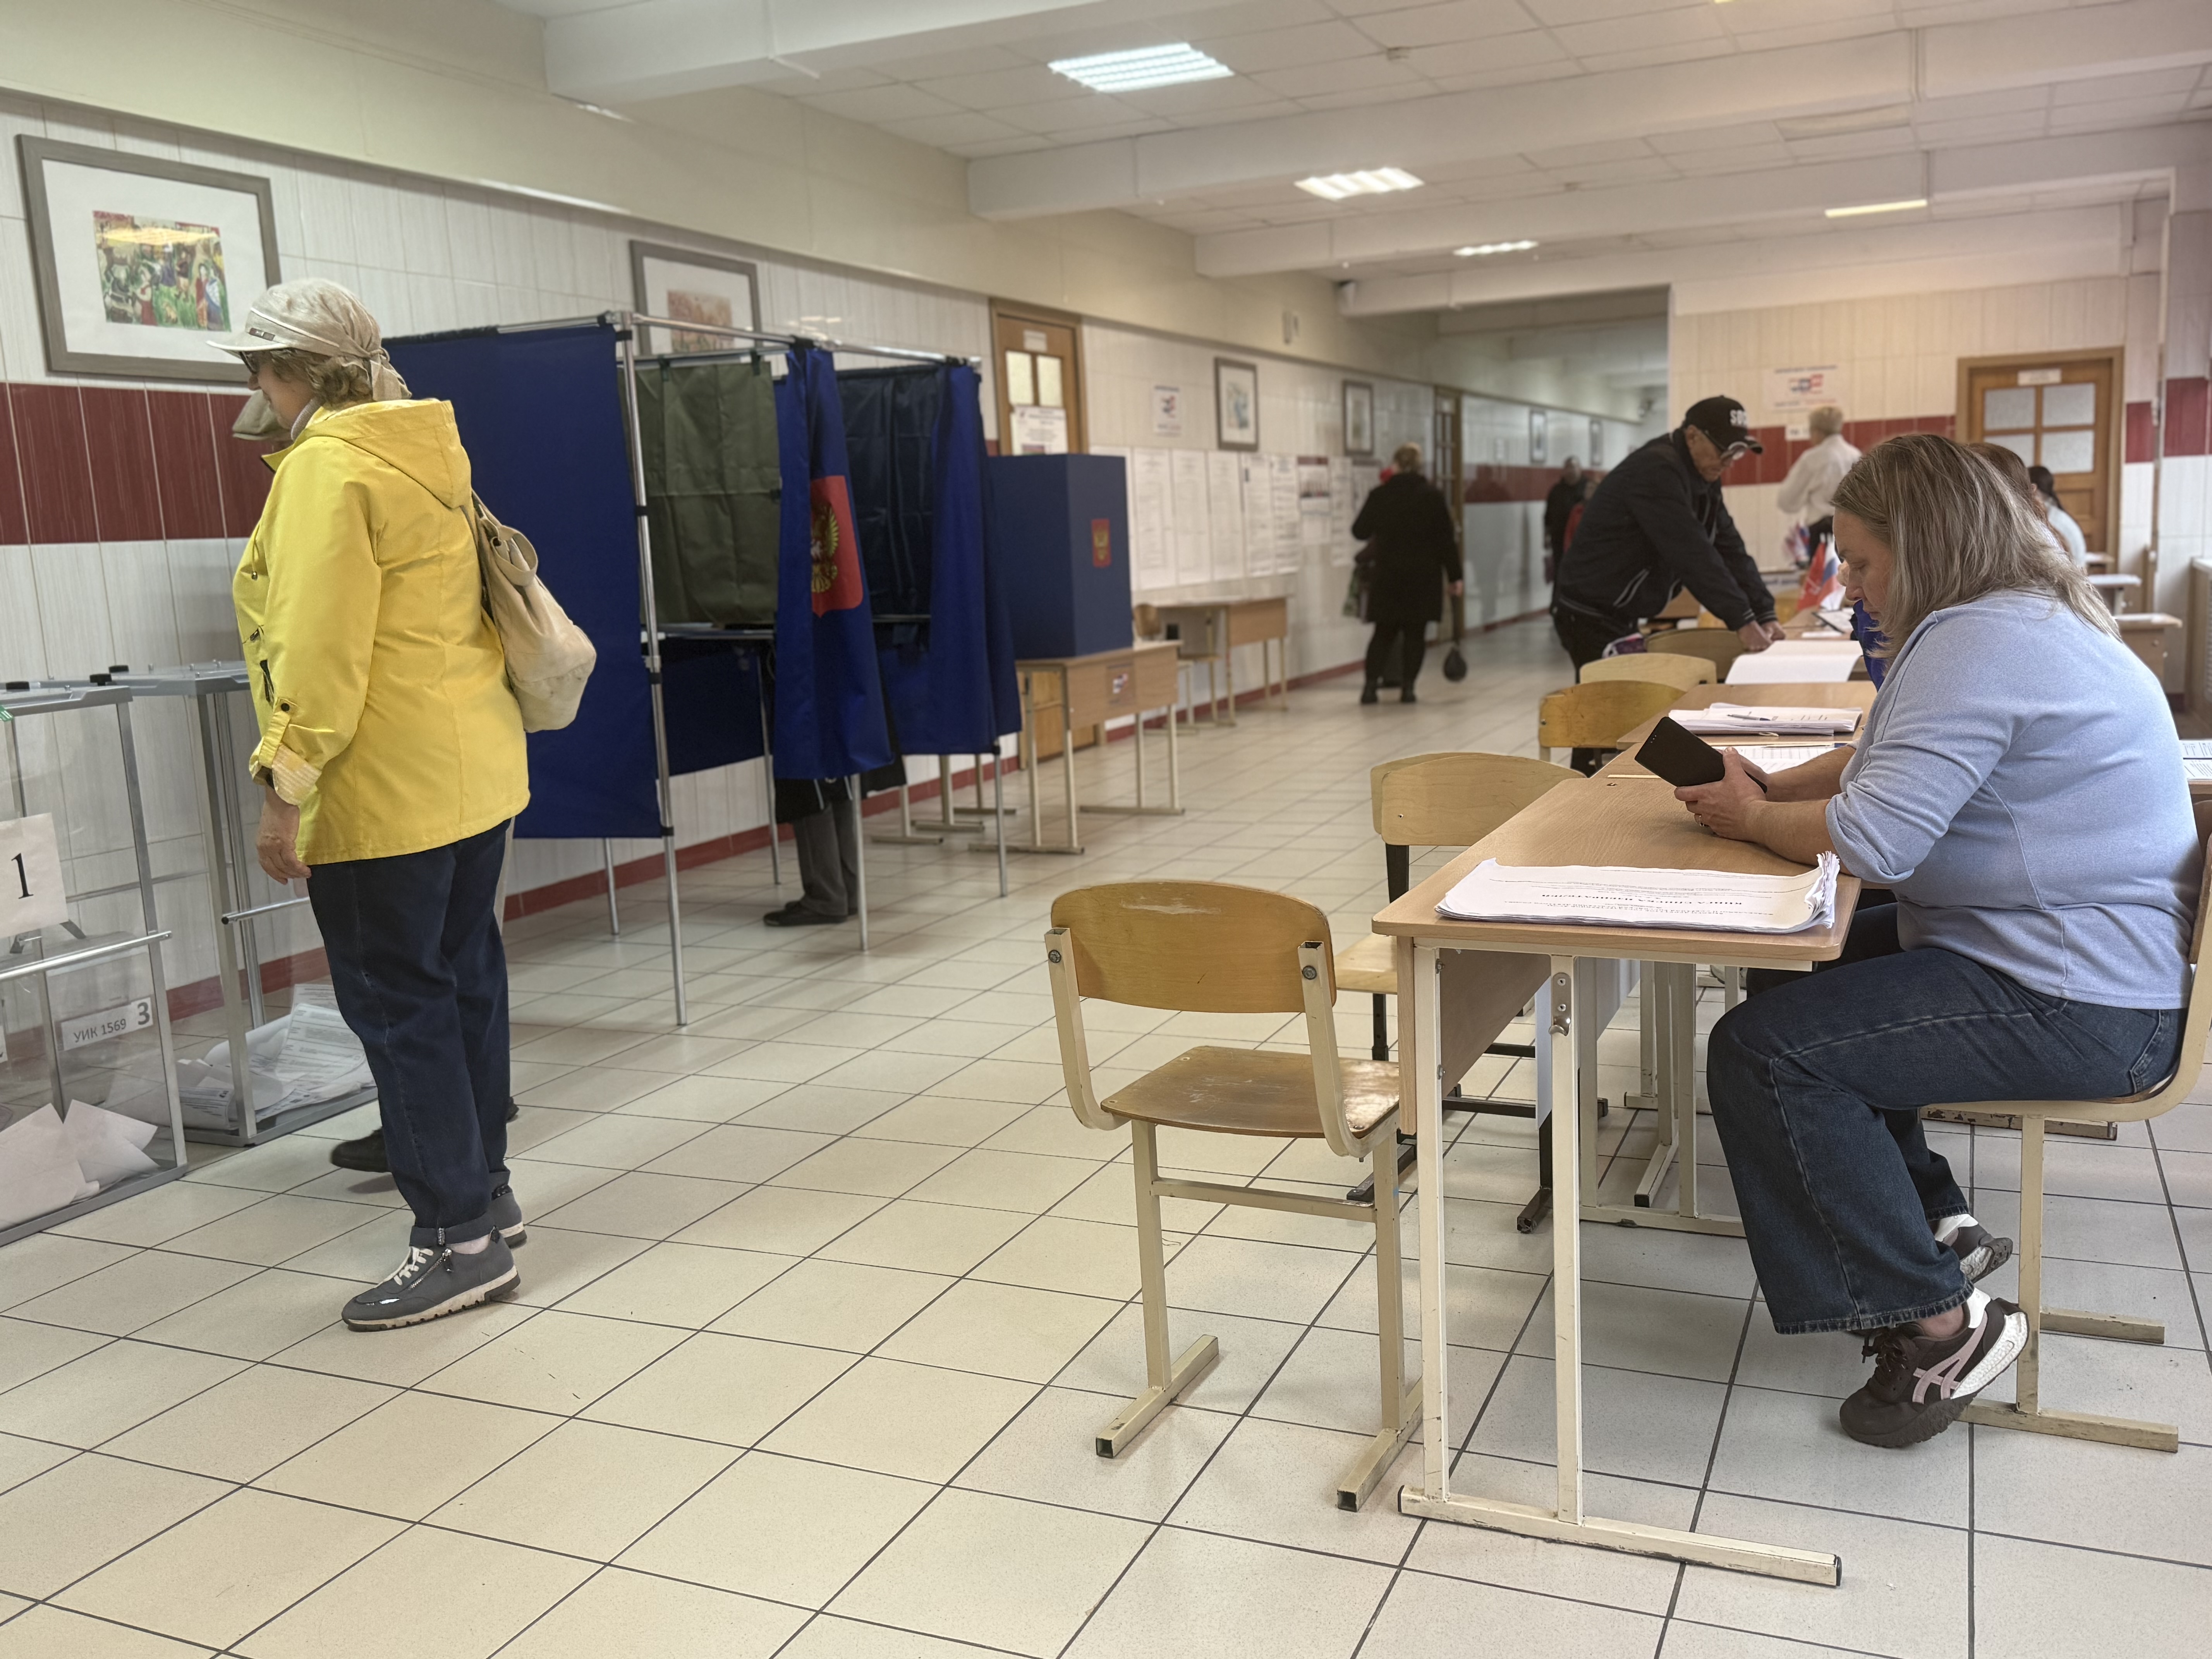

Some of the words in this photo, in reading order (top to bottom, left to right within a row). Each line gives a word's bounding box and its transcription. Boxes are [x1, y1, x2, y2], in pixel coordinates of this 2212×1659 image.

[11, 853, 34, 899] 1
[74, 1025, 98, 1042] УИК
[101, 1018, 127, 1035] 1569
[137, 1002, 150, 1025] 3
